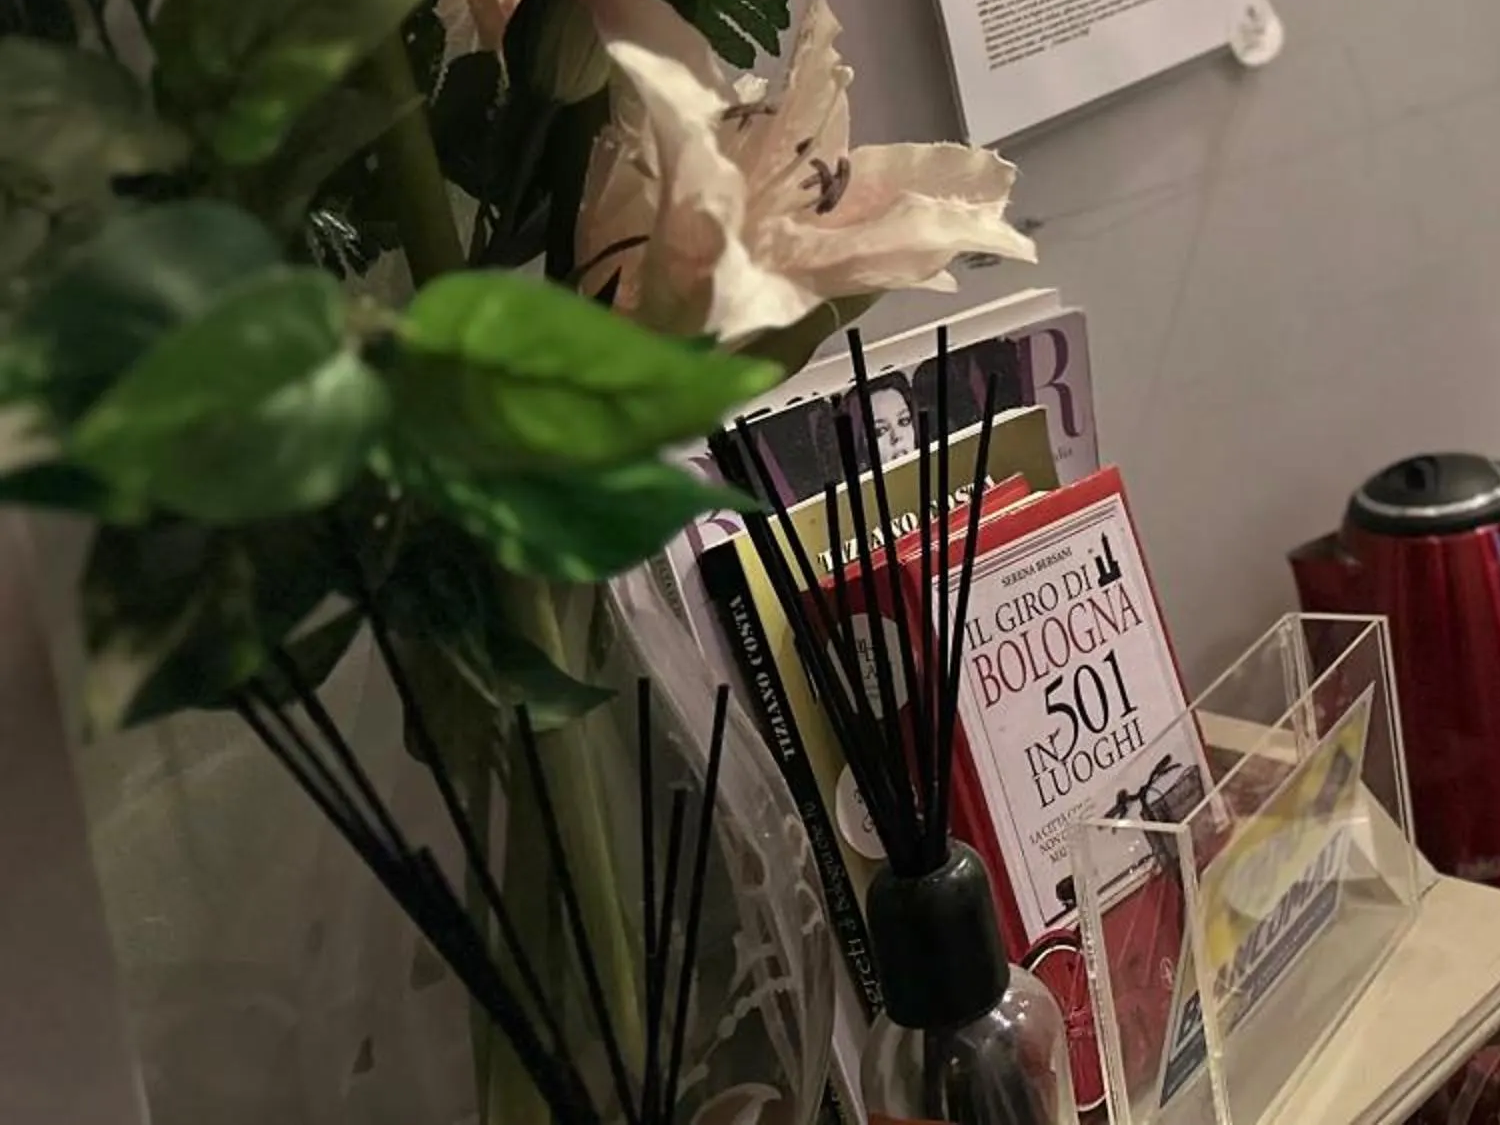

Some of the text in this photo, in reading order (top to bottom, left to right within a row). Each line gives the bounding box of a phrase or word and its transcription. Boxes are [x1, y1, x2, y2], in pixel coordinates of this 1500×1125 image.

[965, 563, 1093, 651] IL GIRO DI
[1001, 547, 1073, 587] SERENA BERSANI
[729, 594, 797, 762] TIZIANO COSTA
[972, 582, 1143, 708] BOLOGNA
[1045, 648, 1138, 762] 501
[1024, 727, 1062, 779] IN
[1033, 717, 1146, 809] LUOGHI
